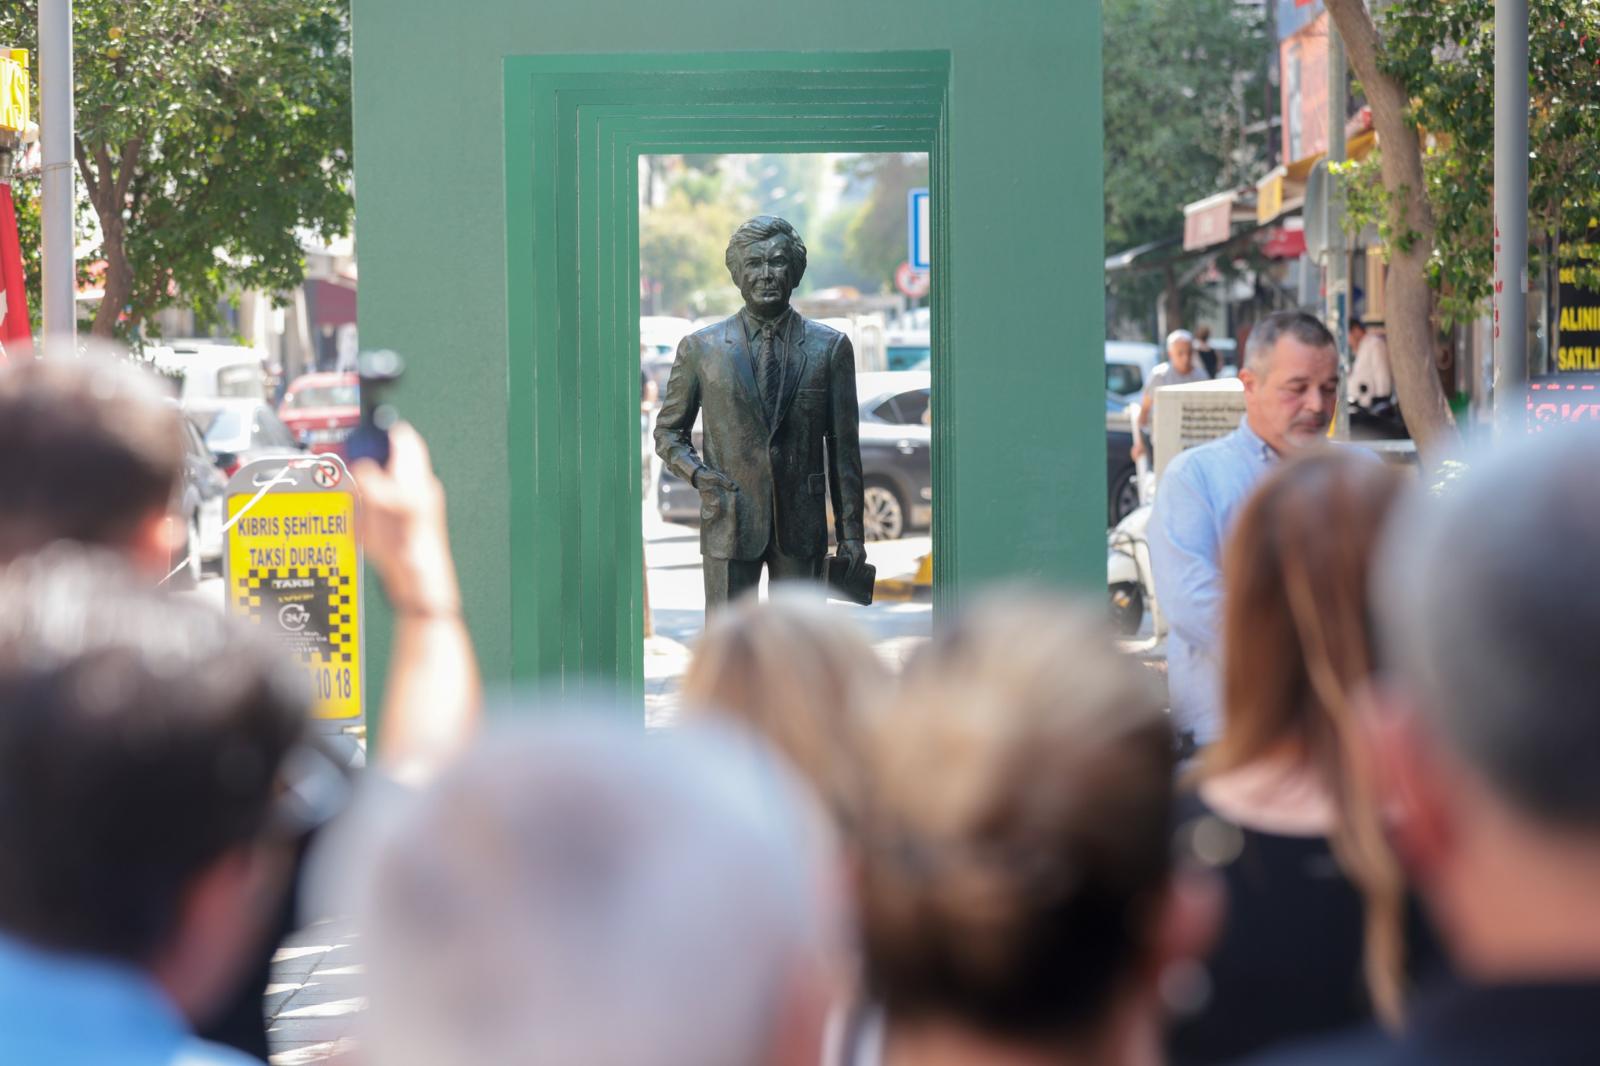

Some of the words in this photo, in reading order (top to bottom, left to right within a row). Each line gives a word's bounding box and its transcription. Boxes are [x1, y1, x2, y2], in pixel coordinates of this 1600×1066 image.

[1560, 306, 1600, 331] ALINI
[238, 516, 279, 536] KIBRIS
[284, 510, 347, 541] ŞEHİTLERİ
[250, 545, 285, 567] TAKSİ
[290, 542, 336, 566] DURAĞI
[336, 667, 351, 699] 18
